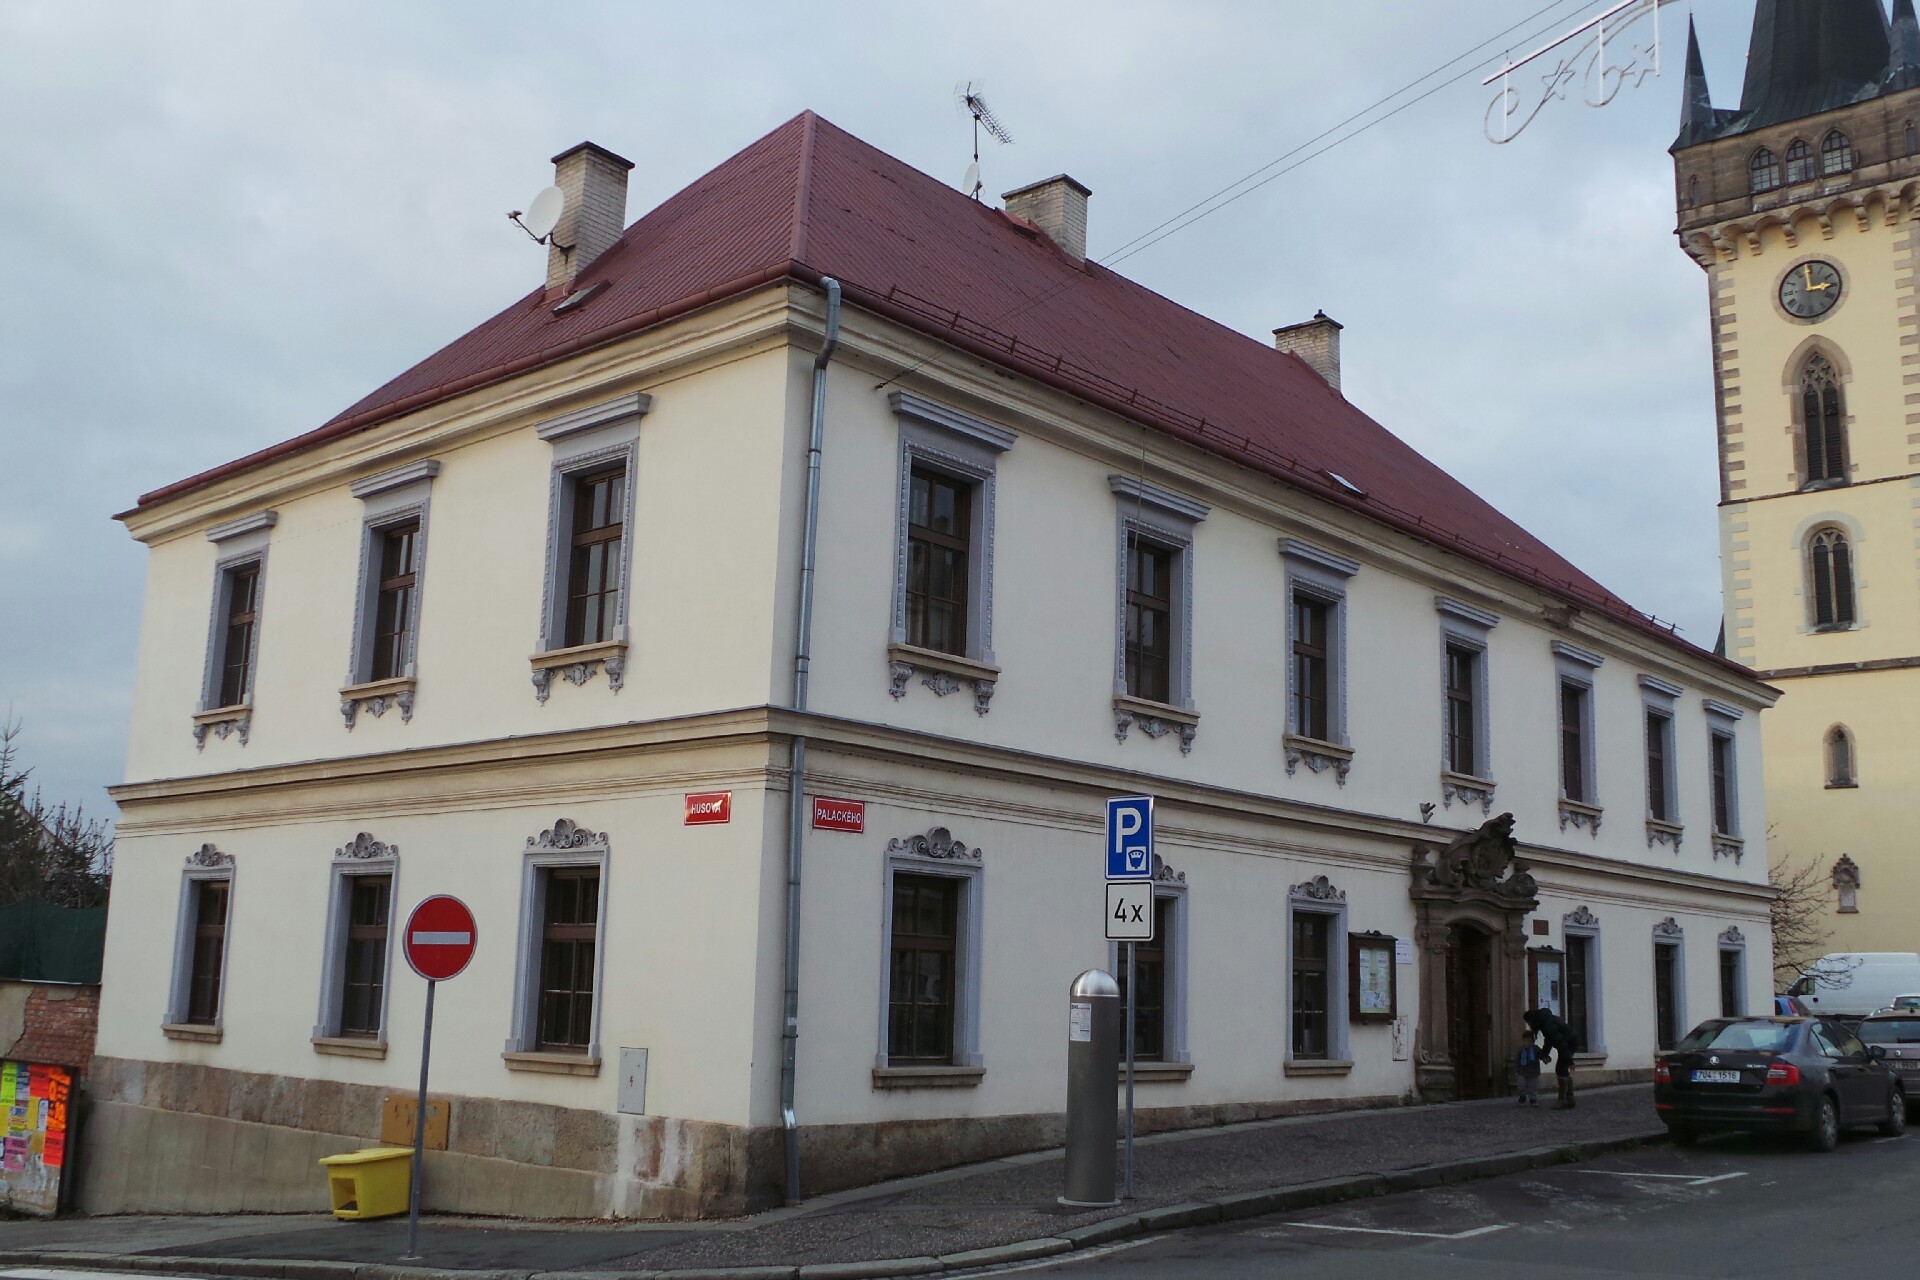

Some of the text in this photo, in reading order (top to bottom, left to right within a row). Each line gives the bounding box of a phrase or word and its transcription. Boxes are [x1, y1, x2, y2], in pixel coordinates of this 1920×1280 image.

[817, 808, 862, 824] PALACKÉHO
[1116, 807, 1142, 853] P
[1114, 898, 1143, 923] 4x
[1698, 1071, 1737, 1080] 7U4 1516
